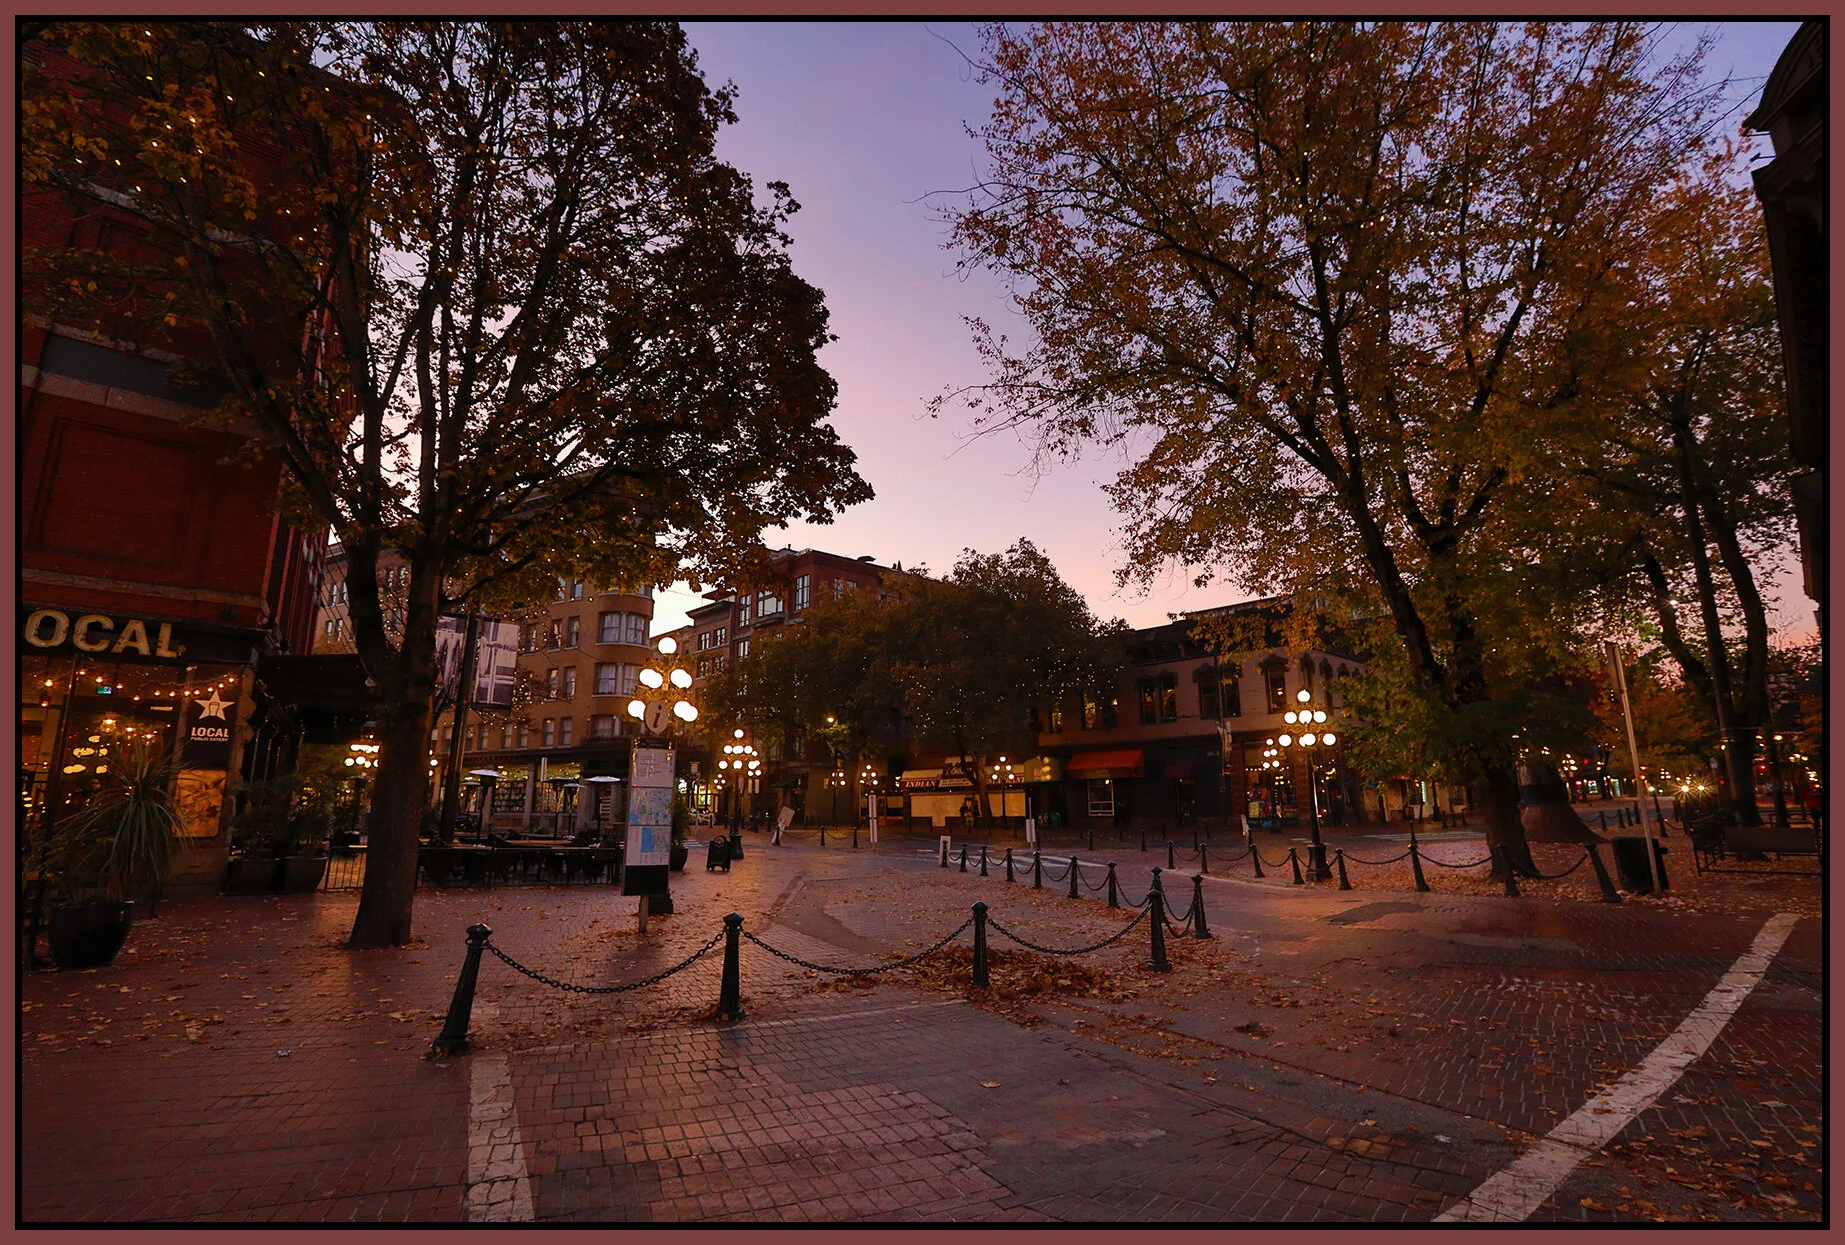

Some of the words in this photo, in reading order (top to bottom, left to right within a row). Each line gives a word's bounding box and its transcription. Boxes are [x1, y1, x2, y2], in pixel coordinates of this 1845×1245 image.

[24, 609, 187, 658] OCAL
[191, 726, 230, 738] LOCAL
[905, 781, 937, 789] INDIAN
